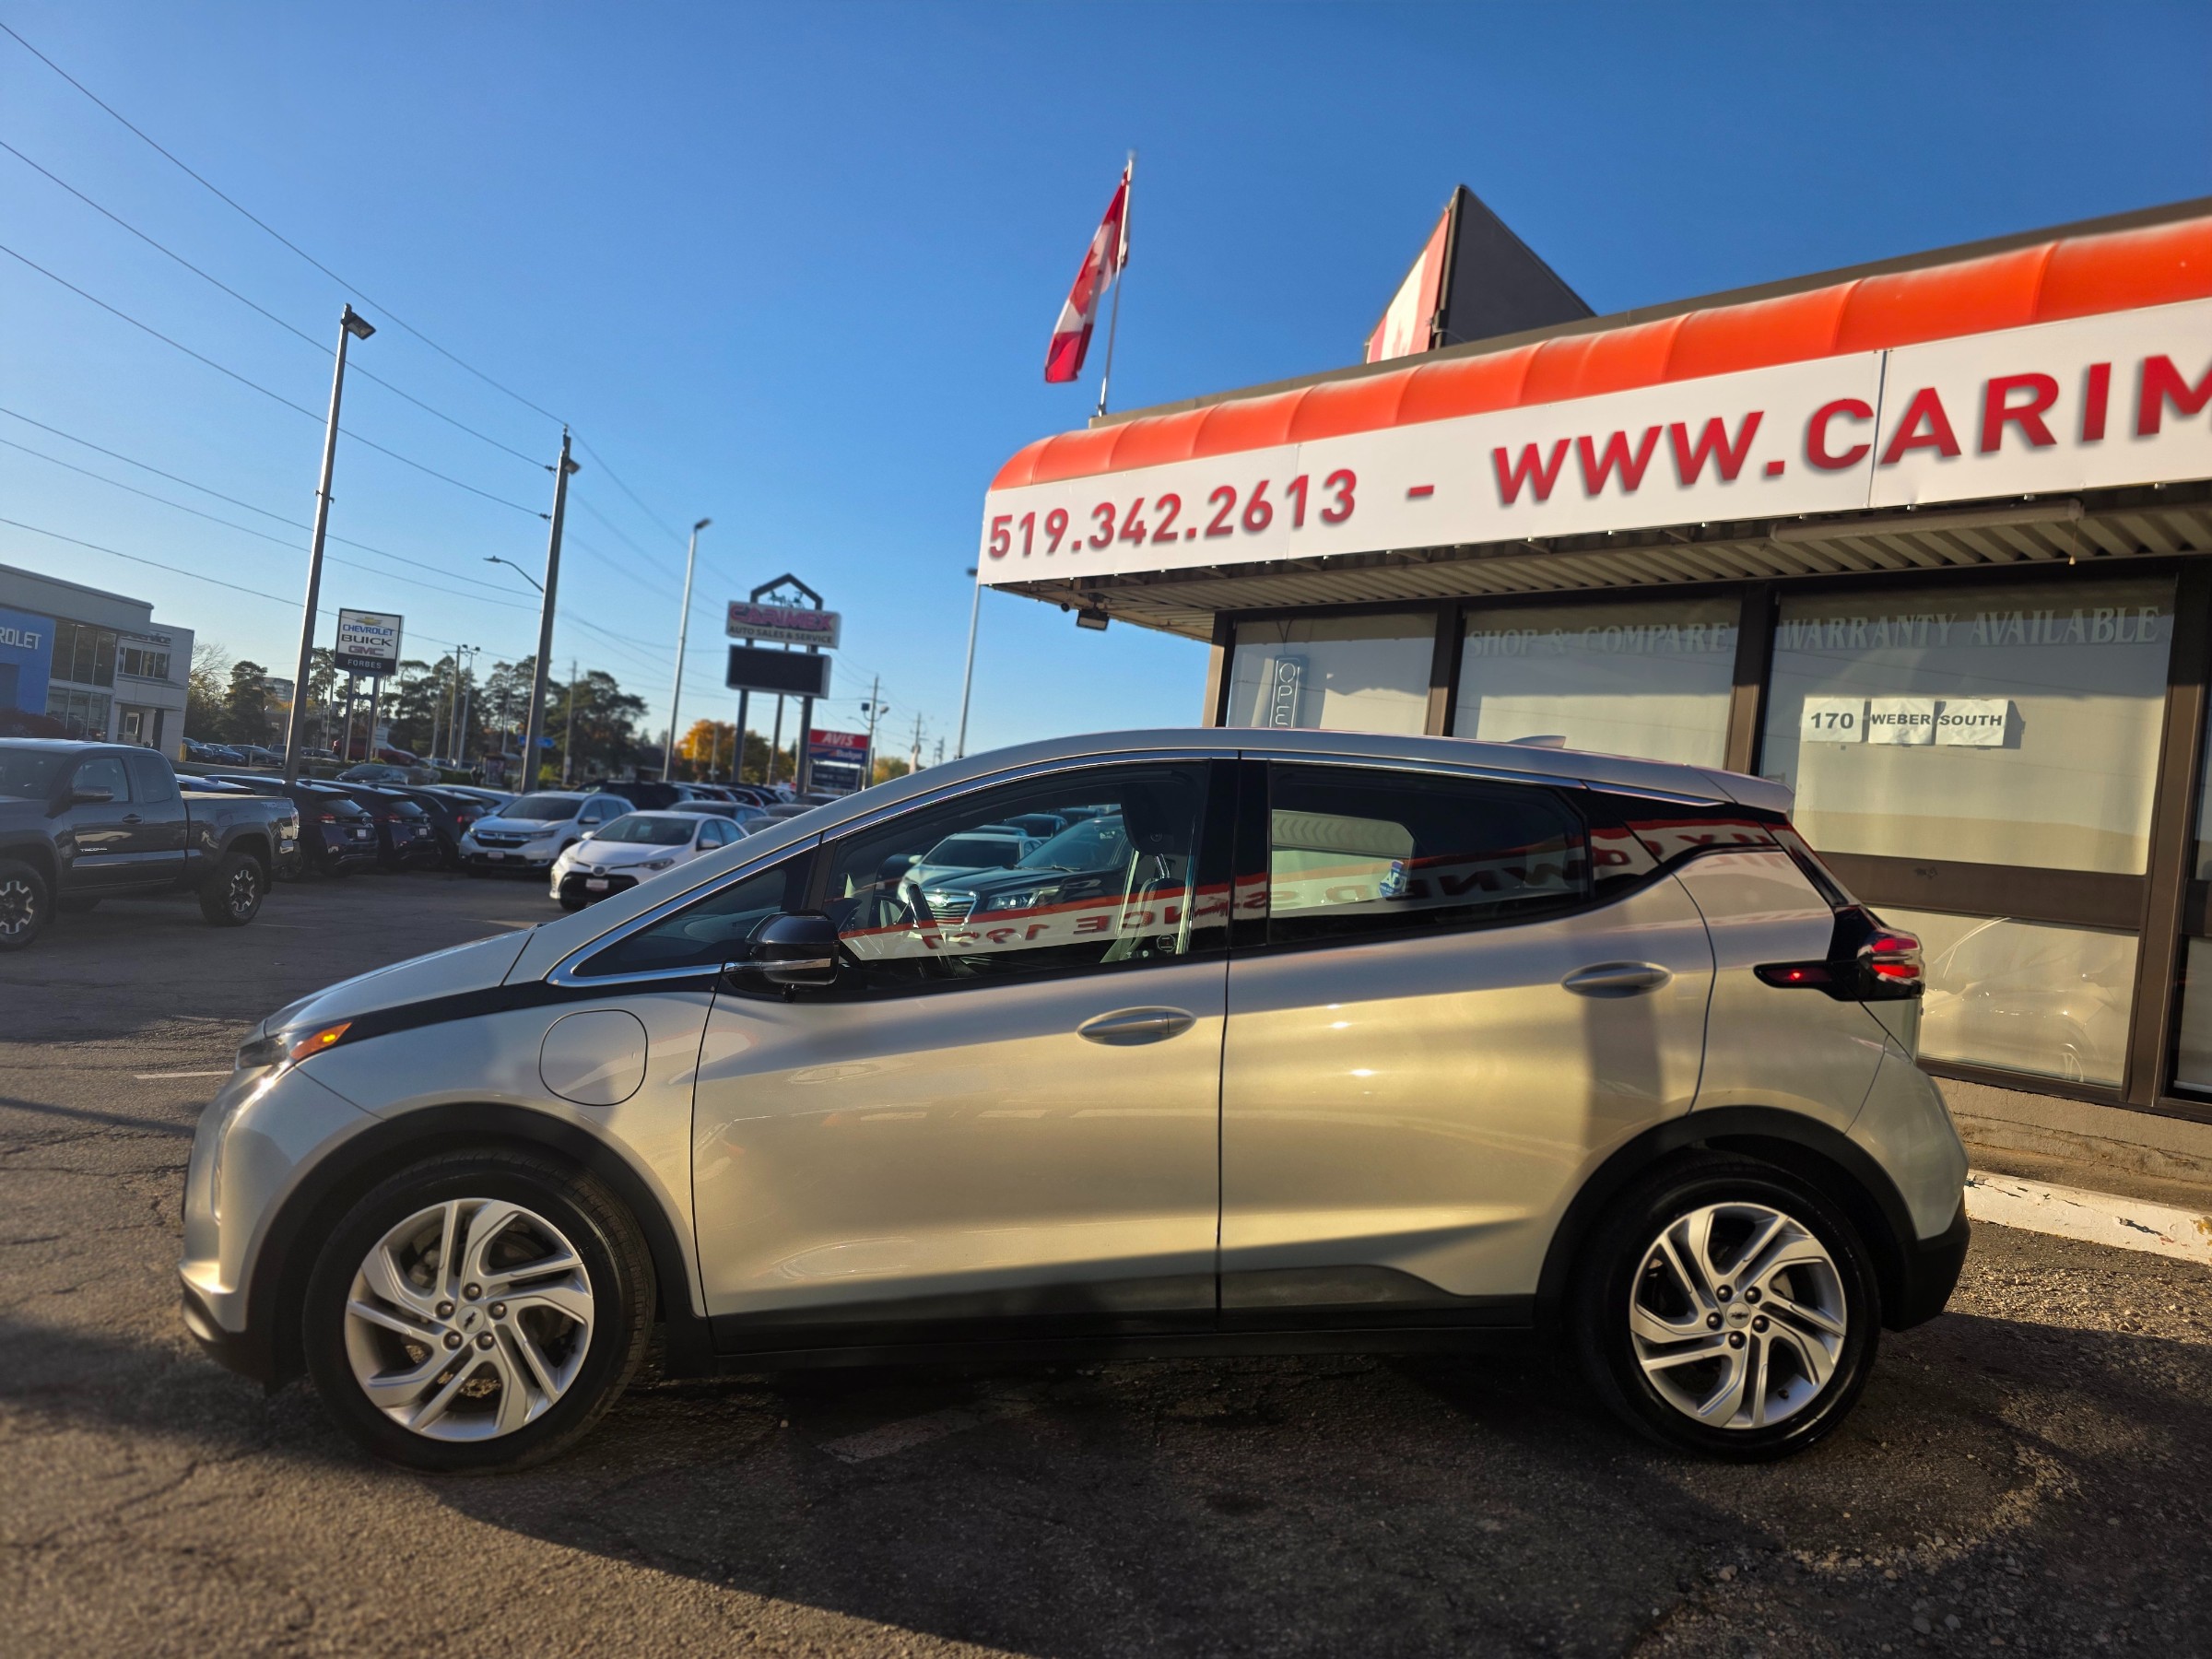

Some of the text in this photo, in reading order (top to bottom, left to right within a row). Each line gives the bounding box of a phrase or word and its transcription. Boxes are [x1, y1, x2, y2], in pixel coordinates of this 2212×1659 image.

[989, 469, 1357, 558] 519.342.2613
[1493, 354, 2212, 505] WWW.CARIM
[731, 605, 835, 631] CARIMEX
[342, 624, 394, 637] CHEVROLET
[729, 626, 755, 636] AUTO
[756, 629, 783, 639] SALES
[795, 633, 833, 644] SERVICE
[1781, 606, 2159, 649] WARRANTY AVAILABLE
[340, 633, 394, 648] BUICK
[1469, 628, 1538, 658] SHOP
[1581, 621, 1731, 654] COMPARE
[348, 645, 384, 656] GMC
[347, 658, 382, 669] FORBES
[1810, 712, 2003, 730] 170 WEBER SOUTH
[822, 733, 855, 747] AVIS
[836, 748, 863, 760] Budget
